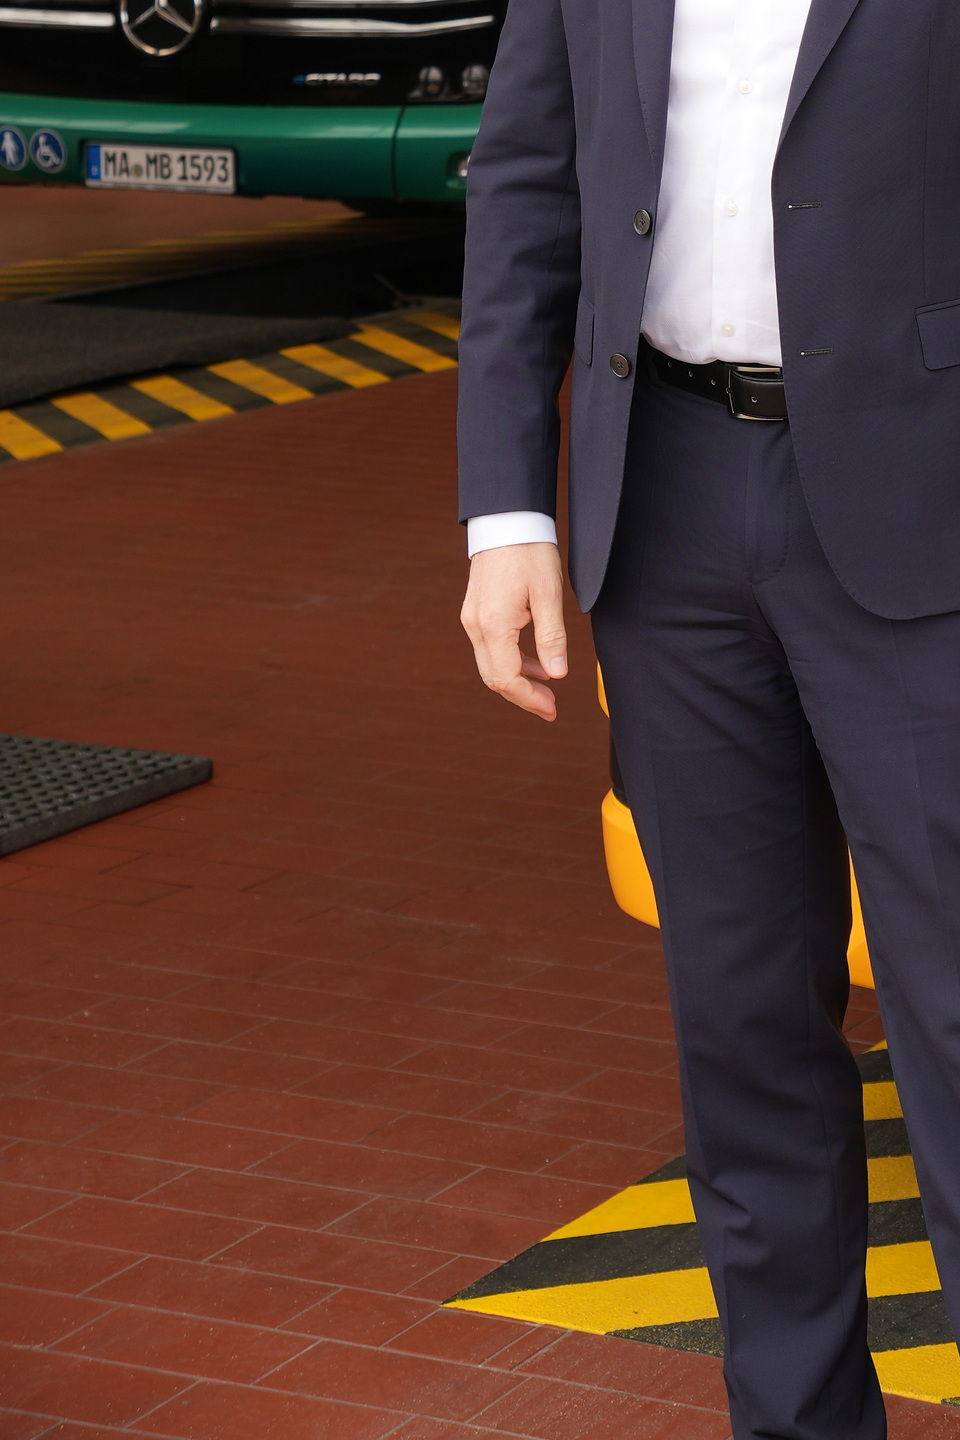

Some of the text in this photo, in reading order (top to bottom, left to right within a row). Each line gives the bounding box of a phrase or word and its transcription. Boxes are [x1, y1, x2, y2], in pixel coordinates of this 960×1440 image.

[104, 151, 229, 184] MA MB 1593
